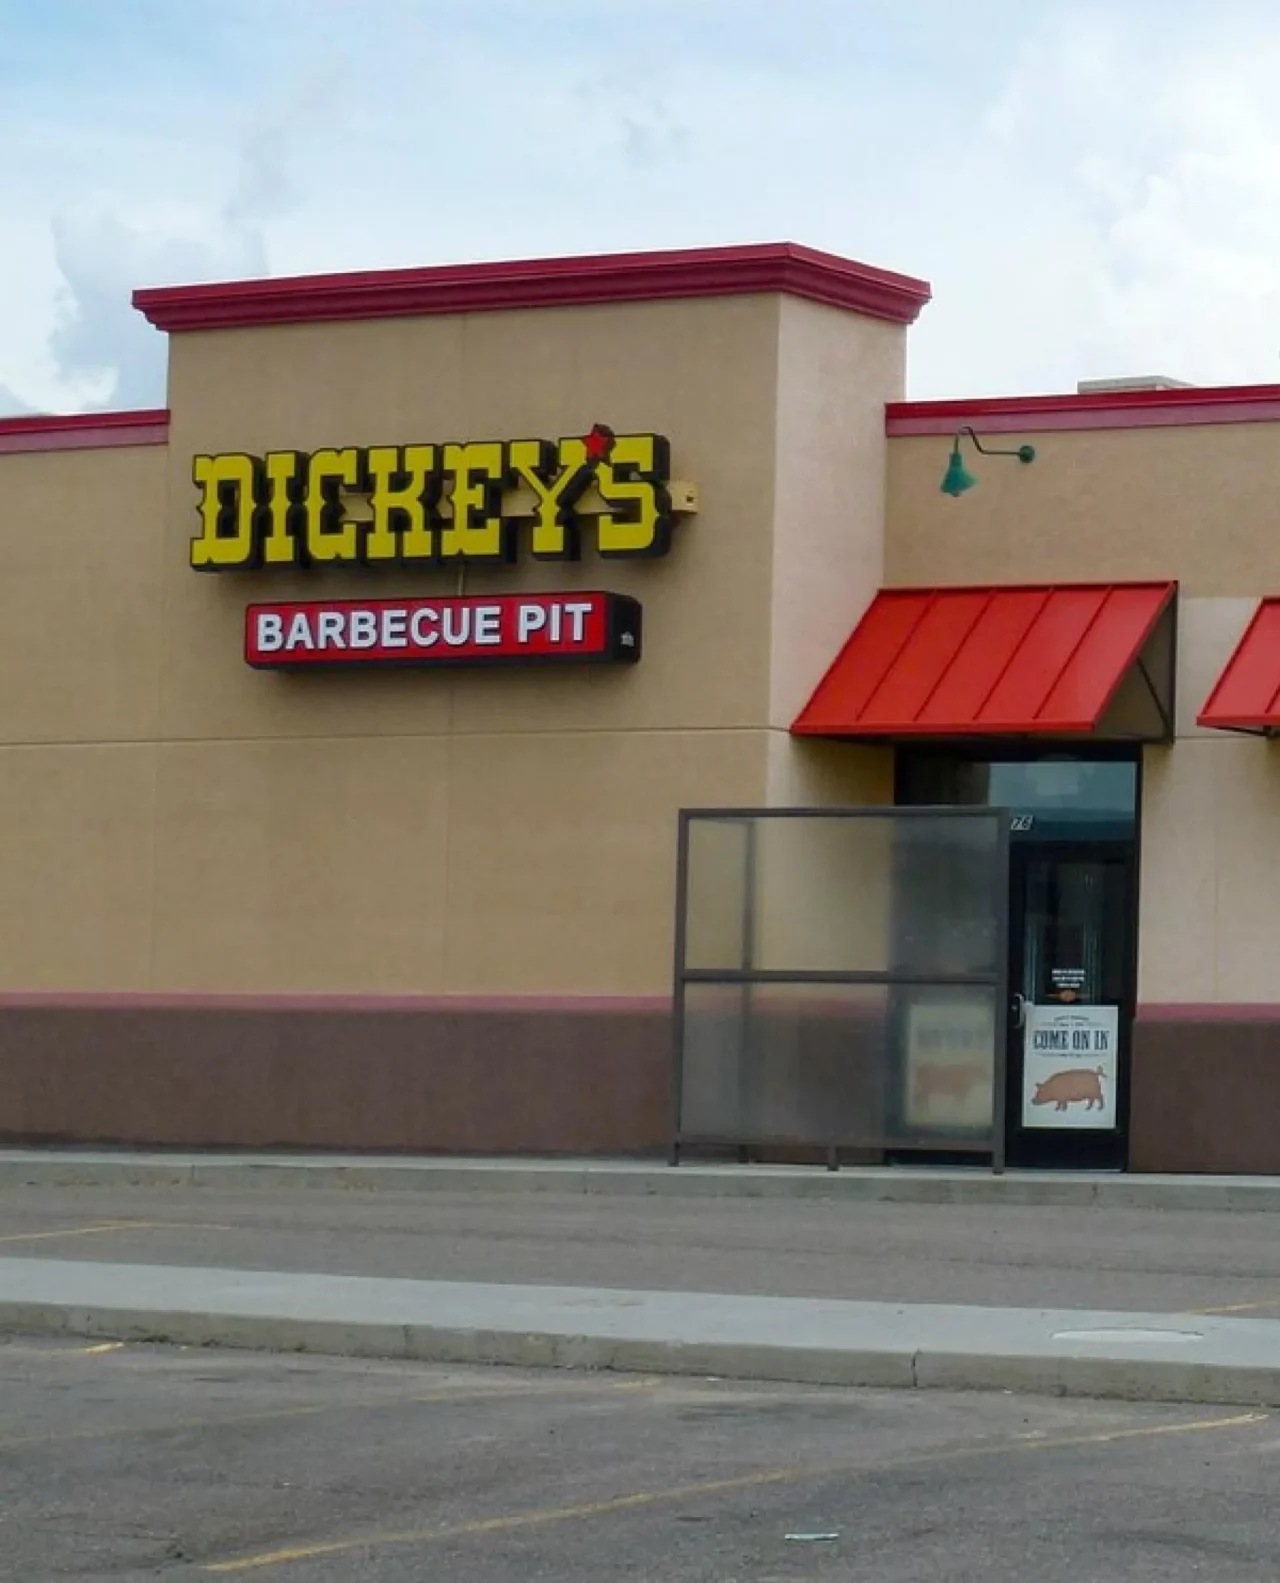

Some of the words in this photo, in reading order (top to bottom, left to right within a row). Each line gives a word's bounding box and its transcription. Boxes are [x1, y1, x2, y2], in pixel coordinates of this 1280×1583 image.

[256, 605, 501, 652] BARBECUE
[517, 602, 593, 643] PIT
[1033, 1029, 1069, 1051] COME
[1072, 1029, 1091, 1051] ON
[1094, 1029, 1110, 1051] IN
